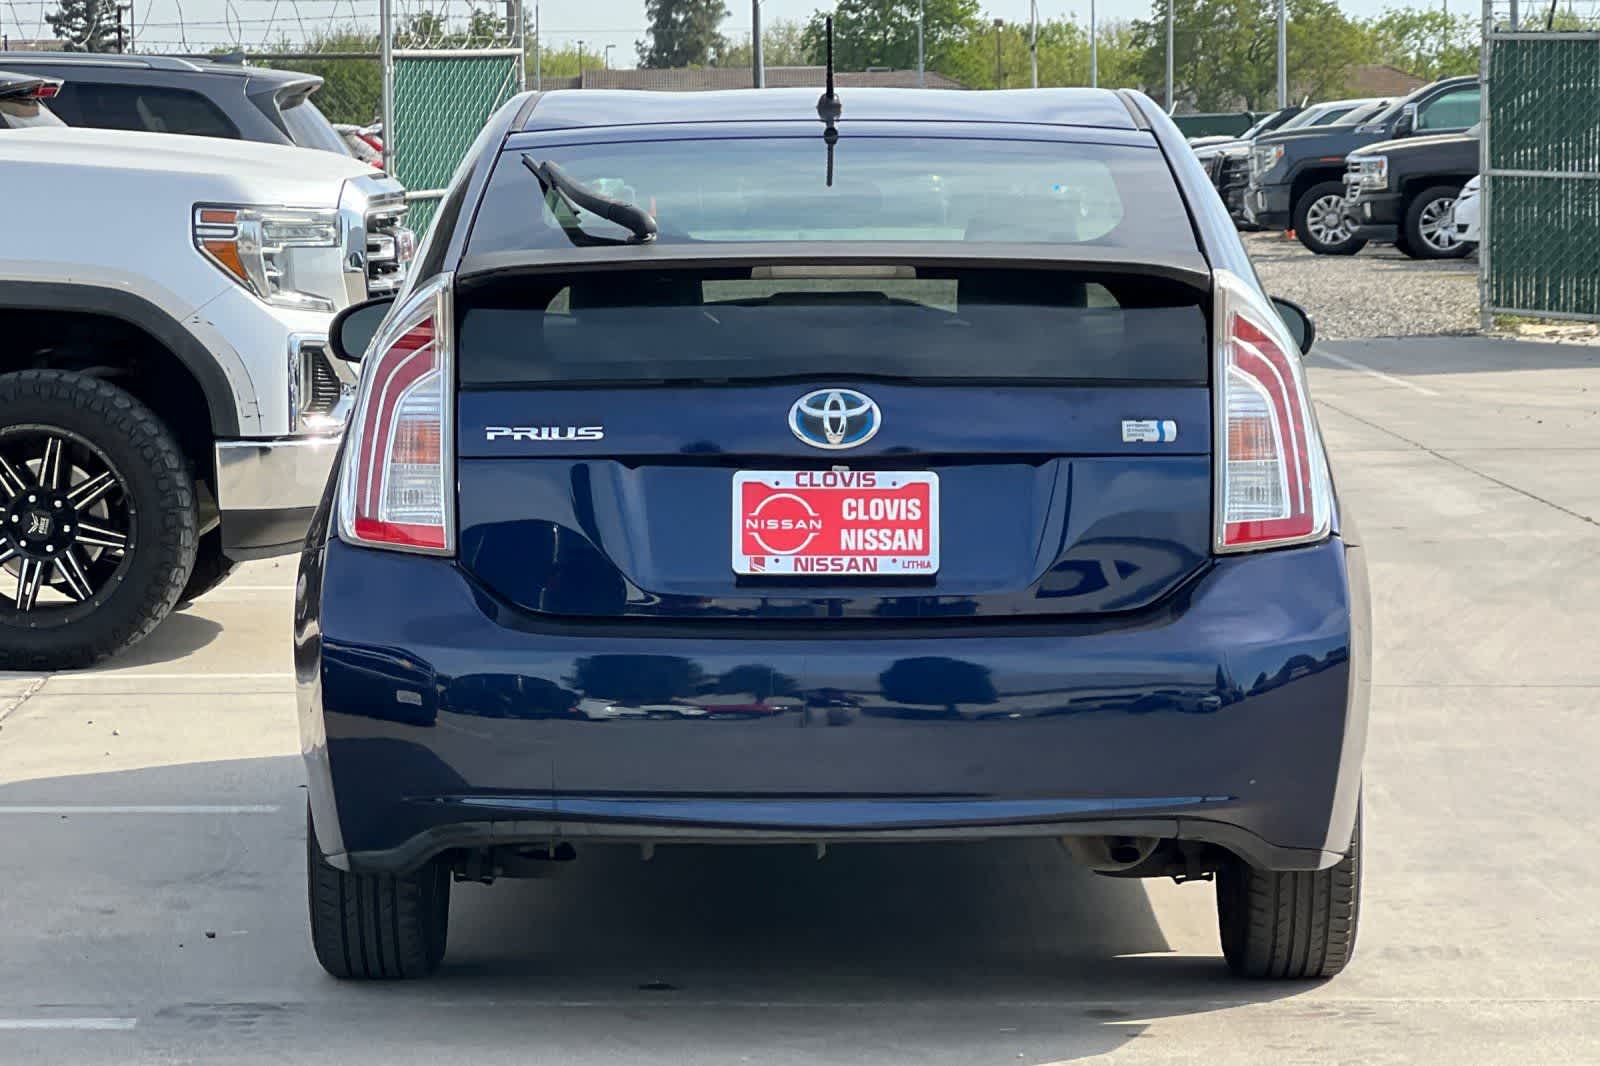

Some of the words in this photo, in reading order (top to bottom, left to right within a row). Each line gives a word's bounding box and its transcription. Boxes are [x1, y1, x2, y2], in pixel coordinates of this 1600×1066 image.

[485, 426, 604, 440] PRIUS
[795, 472, 876, 488] CLOVIS
[842, 498, 921, 520] CLOVIS
[745, 519, 822, 529] NISSAN
[840, 529, 923, 550] NISSAN
[794, 557, 878, 572] NISSAN
[902, 560, 931, 569] LITHIA
